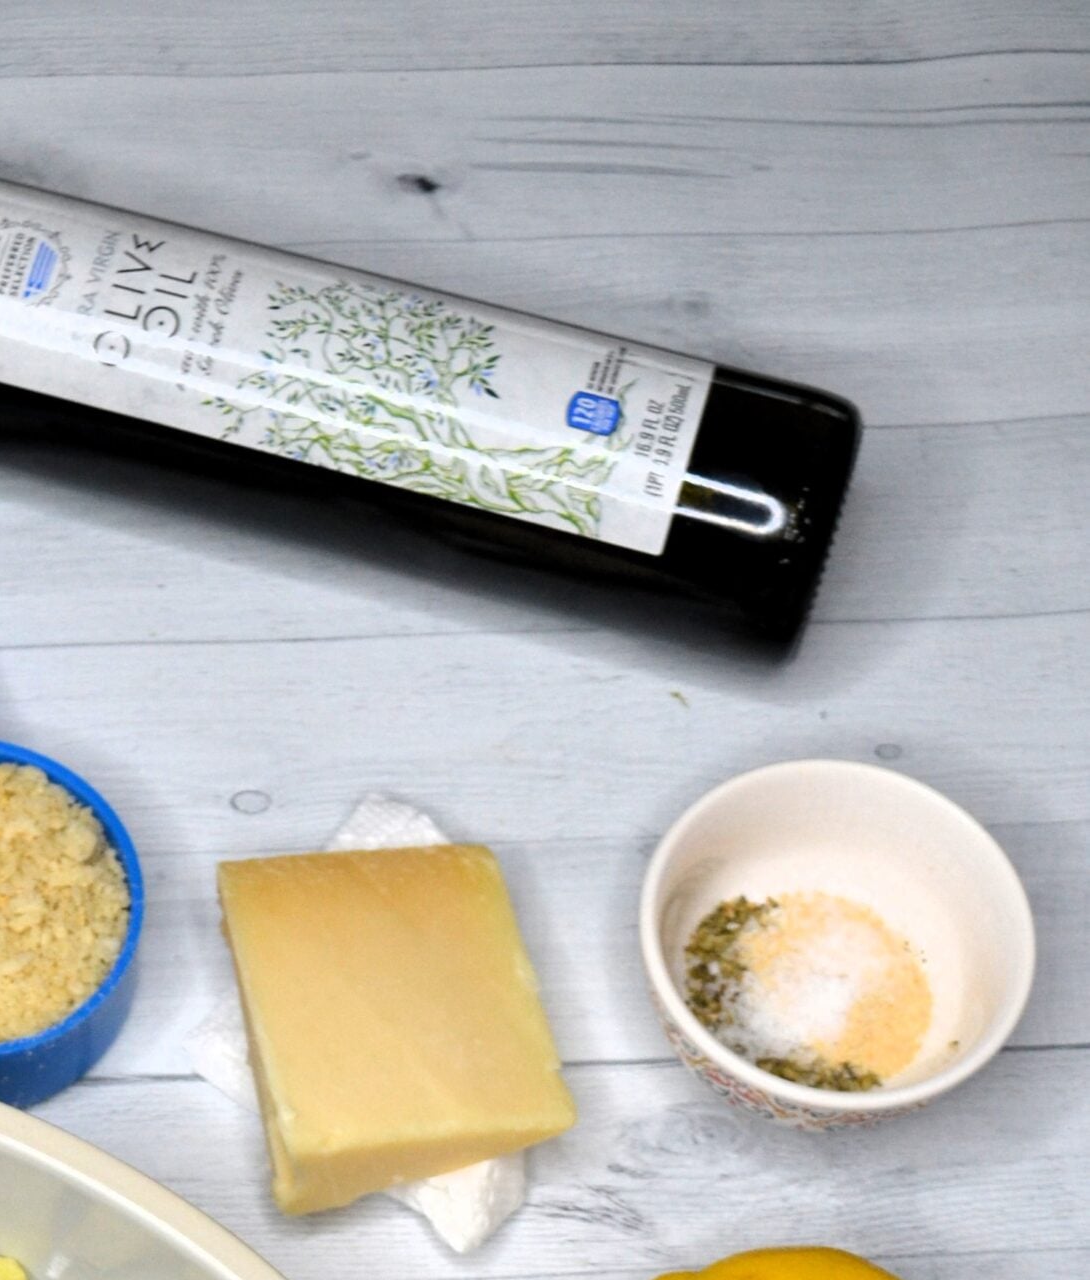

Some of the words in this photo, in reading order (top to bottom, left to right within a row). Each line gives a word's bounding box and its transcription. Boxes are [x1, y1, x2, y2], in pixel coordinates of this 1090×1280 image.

[10, 234, 36, 297] SELECTION
[86, 230, 119, 284] VIRGIN
[93, 233, 166, 367] OLIVE
[142, 270, 197, 338] OIL
[570, 396, 596, 425] 120
[646, 398, 665, 415] OZ
[641, 417, 660, 430] FL
[633, 430, 655, 458] 16.9
[658, 434, 676, 446] FL
